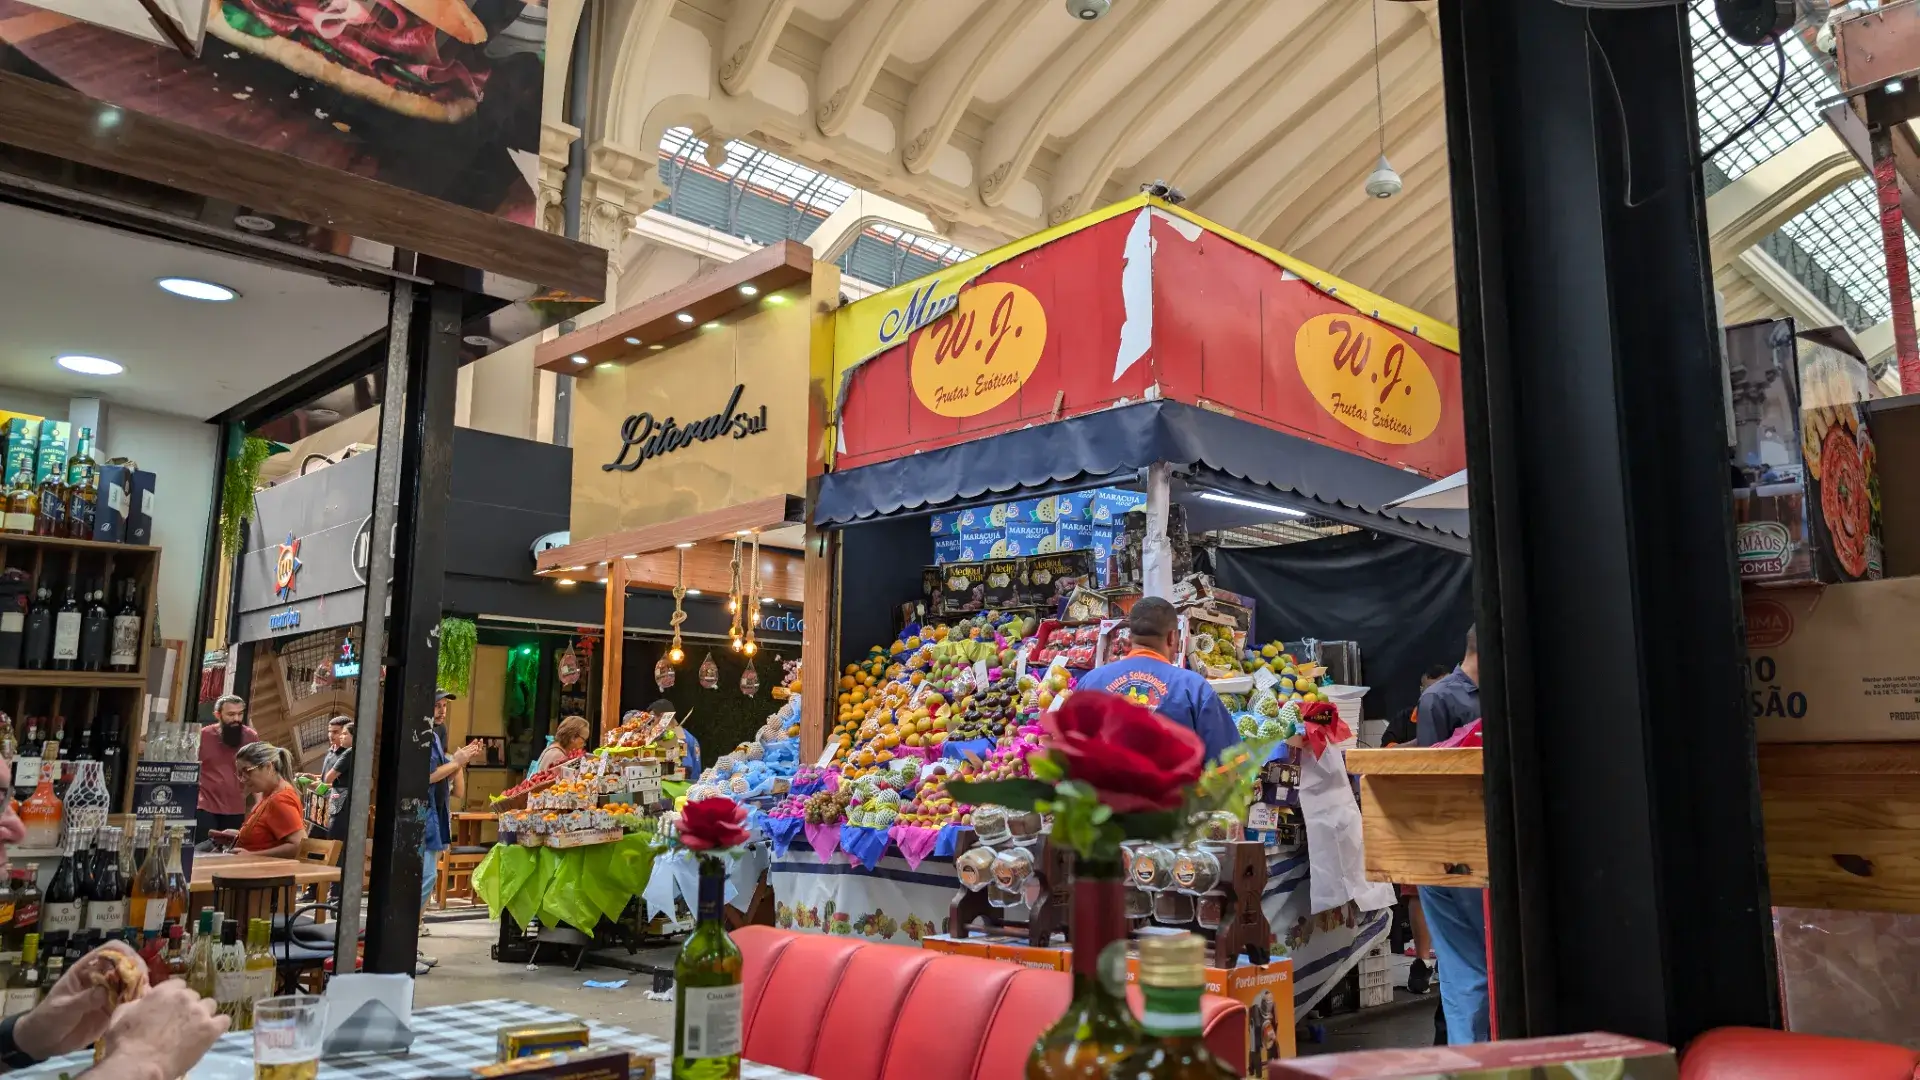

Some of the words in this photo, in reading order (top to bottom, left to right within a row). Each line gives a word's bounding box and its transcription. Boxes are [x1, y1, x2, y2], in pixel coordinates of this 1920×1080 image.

[930, 291, 1023, 365] W.J.
[1328, 318, 1412, 405] W.J.
[933, 385, 970, 410] Frutas
[975, 371, 1021, 397] Exóticas
[1330, 392, 1368, 422] Frutas
[1371, 407, 1413, 437] Exóticas
[601, 383, 745, 473] Litoral
[733, 404, 769, 440] Sul
[1098, 491, 1140, 505] MARACUJÁ
[963, 531, 1001, 541] MARACUJÁ
[1008, 526, 1049, 535] MARACUJÁ
[1737, 531, 1781, 555] RMÃOS
[990, 563, 1015, 574] Medjo
[1105, 674, 1128, 693] Frutas
[1889, 711, 1920, 721] PRODUT
[137, 806, 183, 814] PAULANER
[1235, 975, 1255, 990] Porta
